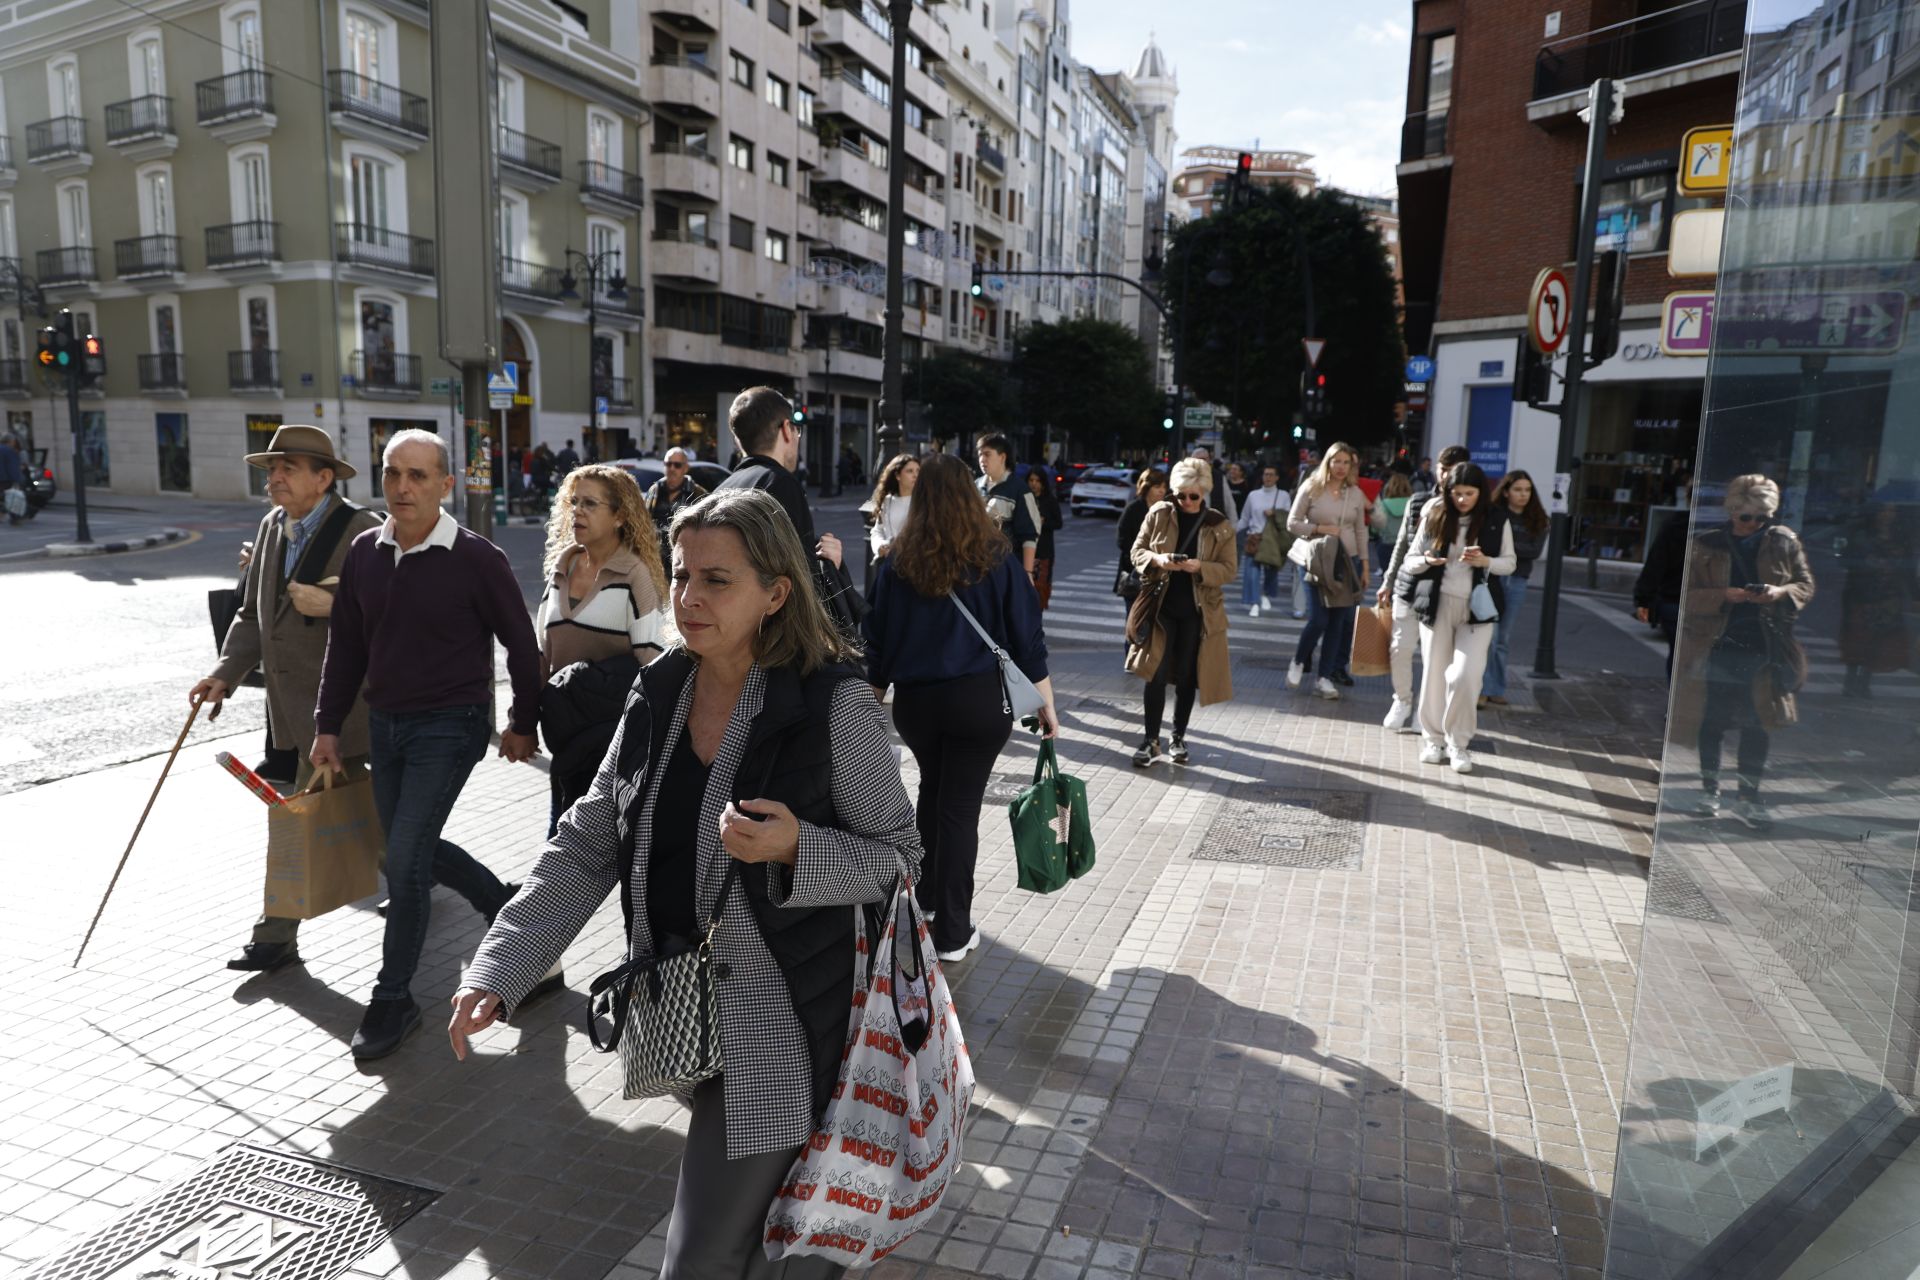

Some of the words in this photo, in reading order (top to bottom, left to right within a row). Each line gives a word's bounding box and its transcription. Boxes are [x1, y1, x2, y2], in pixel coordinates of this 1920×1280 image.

[1614, 158, 1669, 174] Consultores
[853, 1081, 909, 1117] MICKEY
[840, 1135, 897, 1168] MICKEY
[825, 1185, 884, 1215] MICKEY
[806, 1231, 867, 1255] MICKEY
